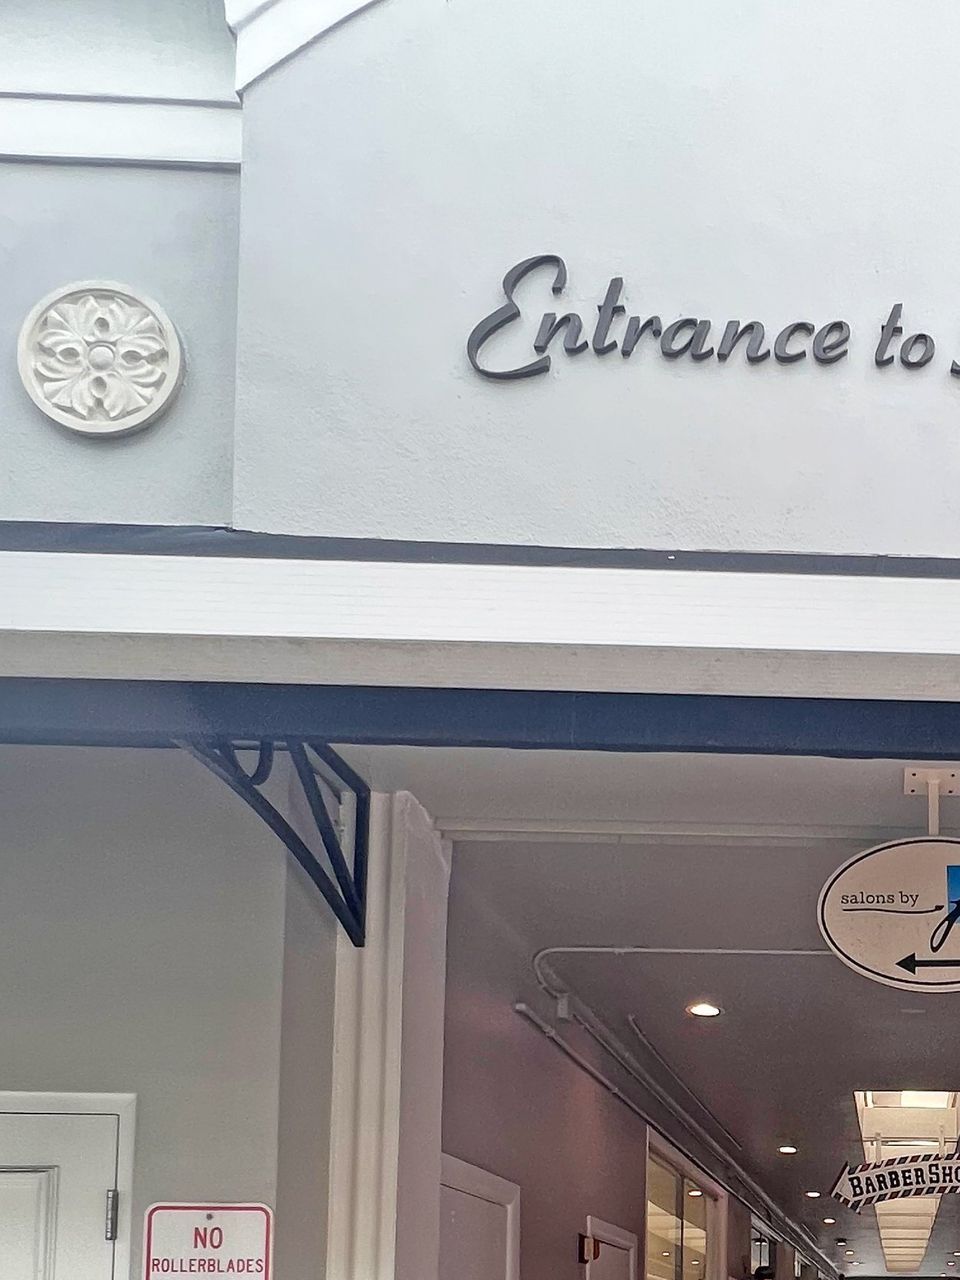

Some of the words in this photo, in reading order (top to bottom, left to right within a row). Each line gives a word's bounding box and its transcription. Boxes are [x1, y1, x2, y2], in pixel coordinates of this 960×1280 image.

[466, 254, 851, 386] Entrance
[874, 303, 936, 372] to
[840, 891, 895, 905] salons
[899, 890, 919, 907] by
[193, 1226, 224, 1249] NO
[151, 1258, 264, 1273] ROLLERBLADES
